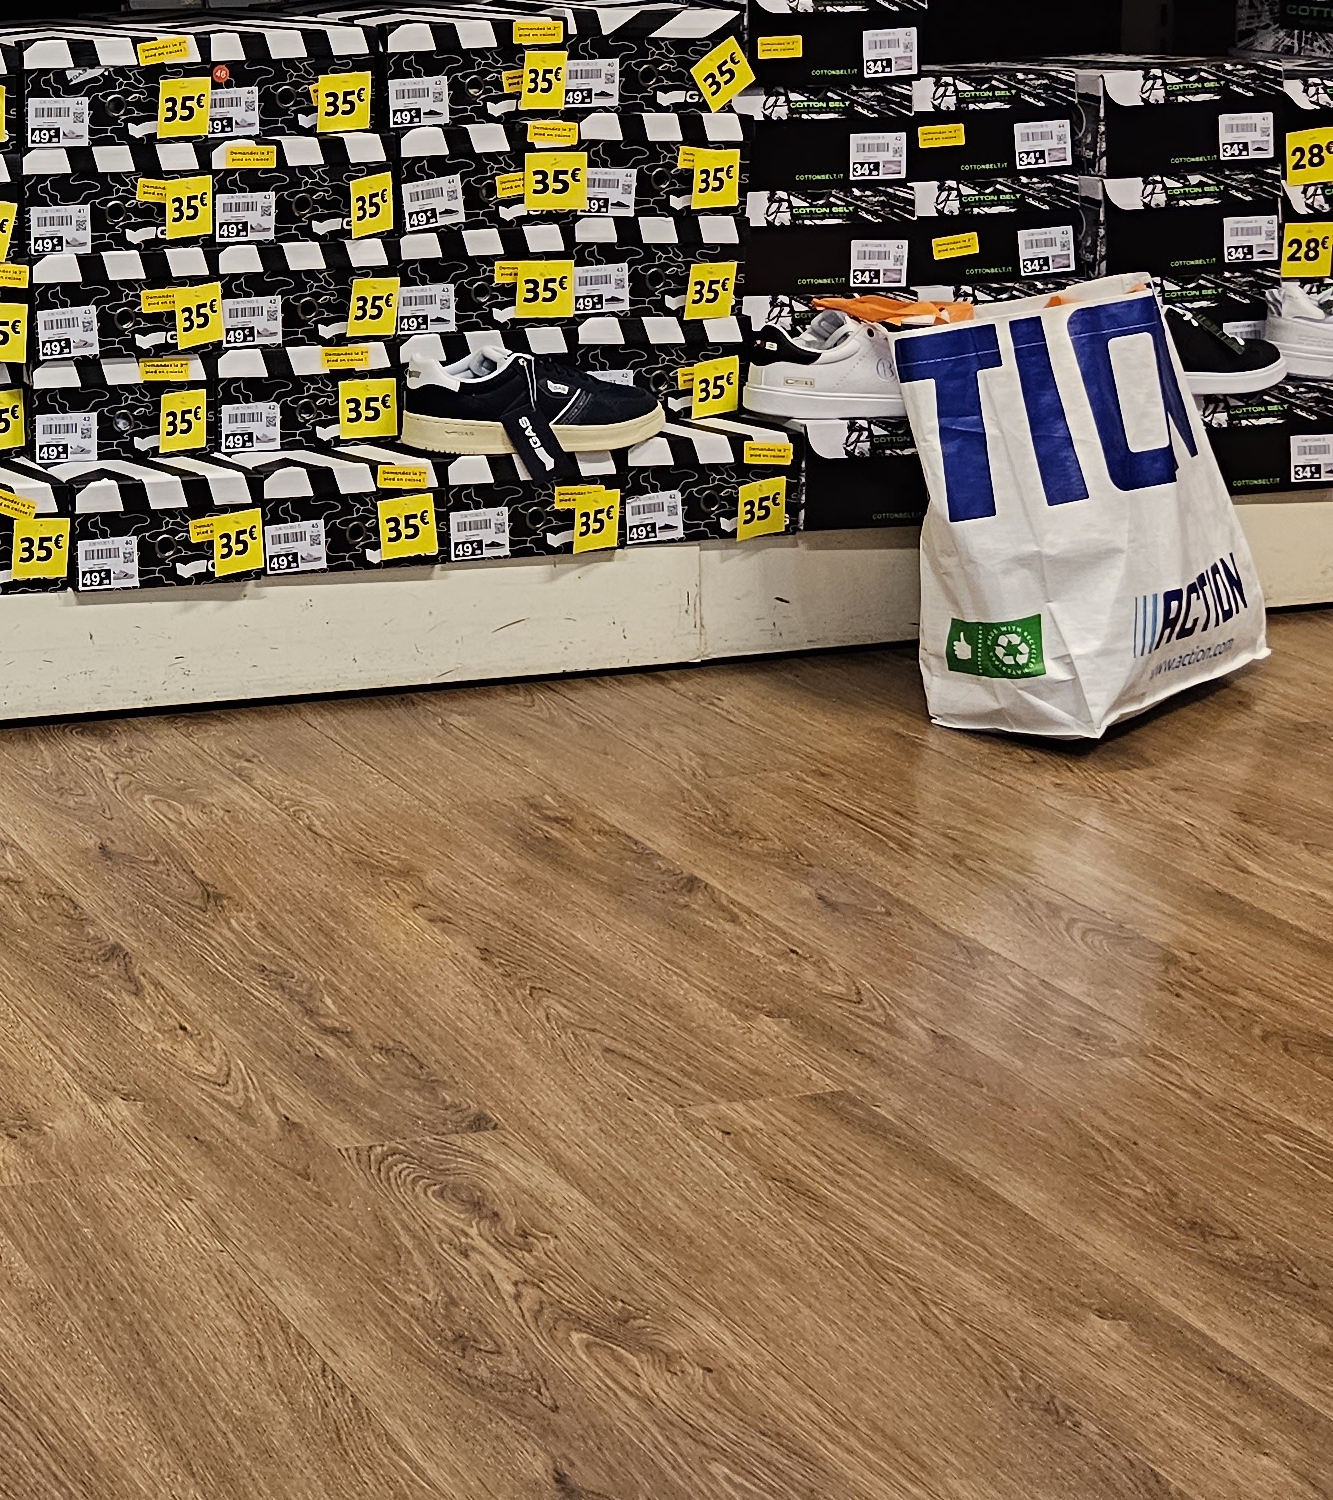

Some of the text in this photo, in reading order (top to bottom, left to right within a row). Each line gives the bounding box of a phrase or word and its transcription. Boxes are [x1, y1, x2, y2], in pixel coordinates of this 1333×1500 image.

[527, 67, 562, 93] 35€
[703, 52, 740, 96] 35€
[1166, 80, 1226, 92] COTTON BELT
[325, 88, 365, 116] 35€
[789, 100, 851, 109] COTTON BELT
[957, 89, 1017, 98] COTTON BELT
[164, 94, 205, 122] 35€
[532, 168, 581, 194] 35€
[698, 165, 734, 193] 35€
[172, 192, 207, 222] 35€
[356, 189, 387, 221] 35€
[792, 205, 855, 215] COTTON BELT
[961, 193, 1022, 203] COTTON BELT
[1287, 236, 1329, 261] 28€
[523, 276, 567, 303] 35€
[692, 278, 729, 304] 35€
[1164, 287, 1224, 298] COTTON BELT
[181, 299, 217, 332] 35€
[354, 293, 393, 320] 35€
[699, 372, 733, 402] 35€
[166, 406, 201, 436] 35€
[346, 394, 391, 423] 35€
[1229, 403, 1290, 414] COTTON BELT
[579, 505, 614, 536] 35€
[743, 492, 780, 524] 35€
[386, 510, 429, 542] 35€
[19, 534, 63, 562] 35€
[219, 525, 257, 559] 35€
[1153, 551, 1249, 652] ACTION
